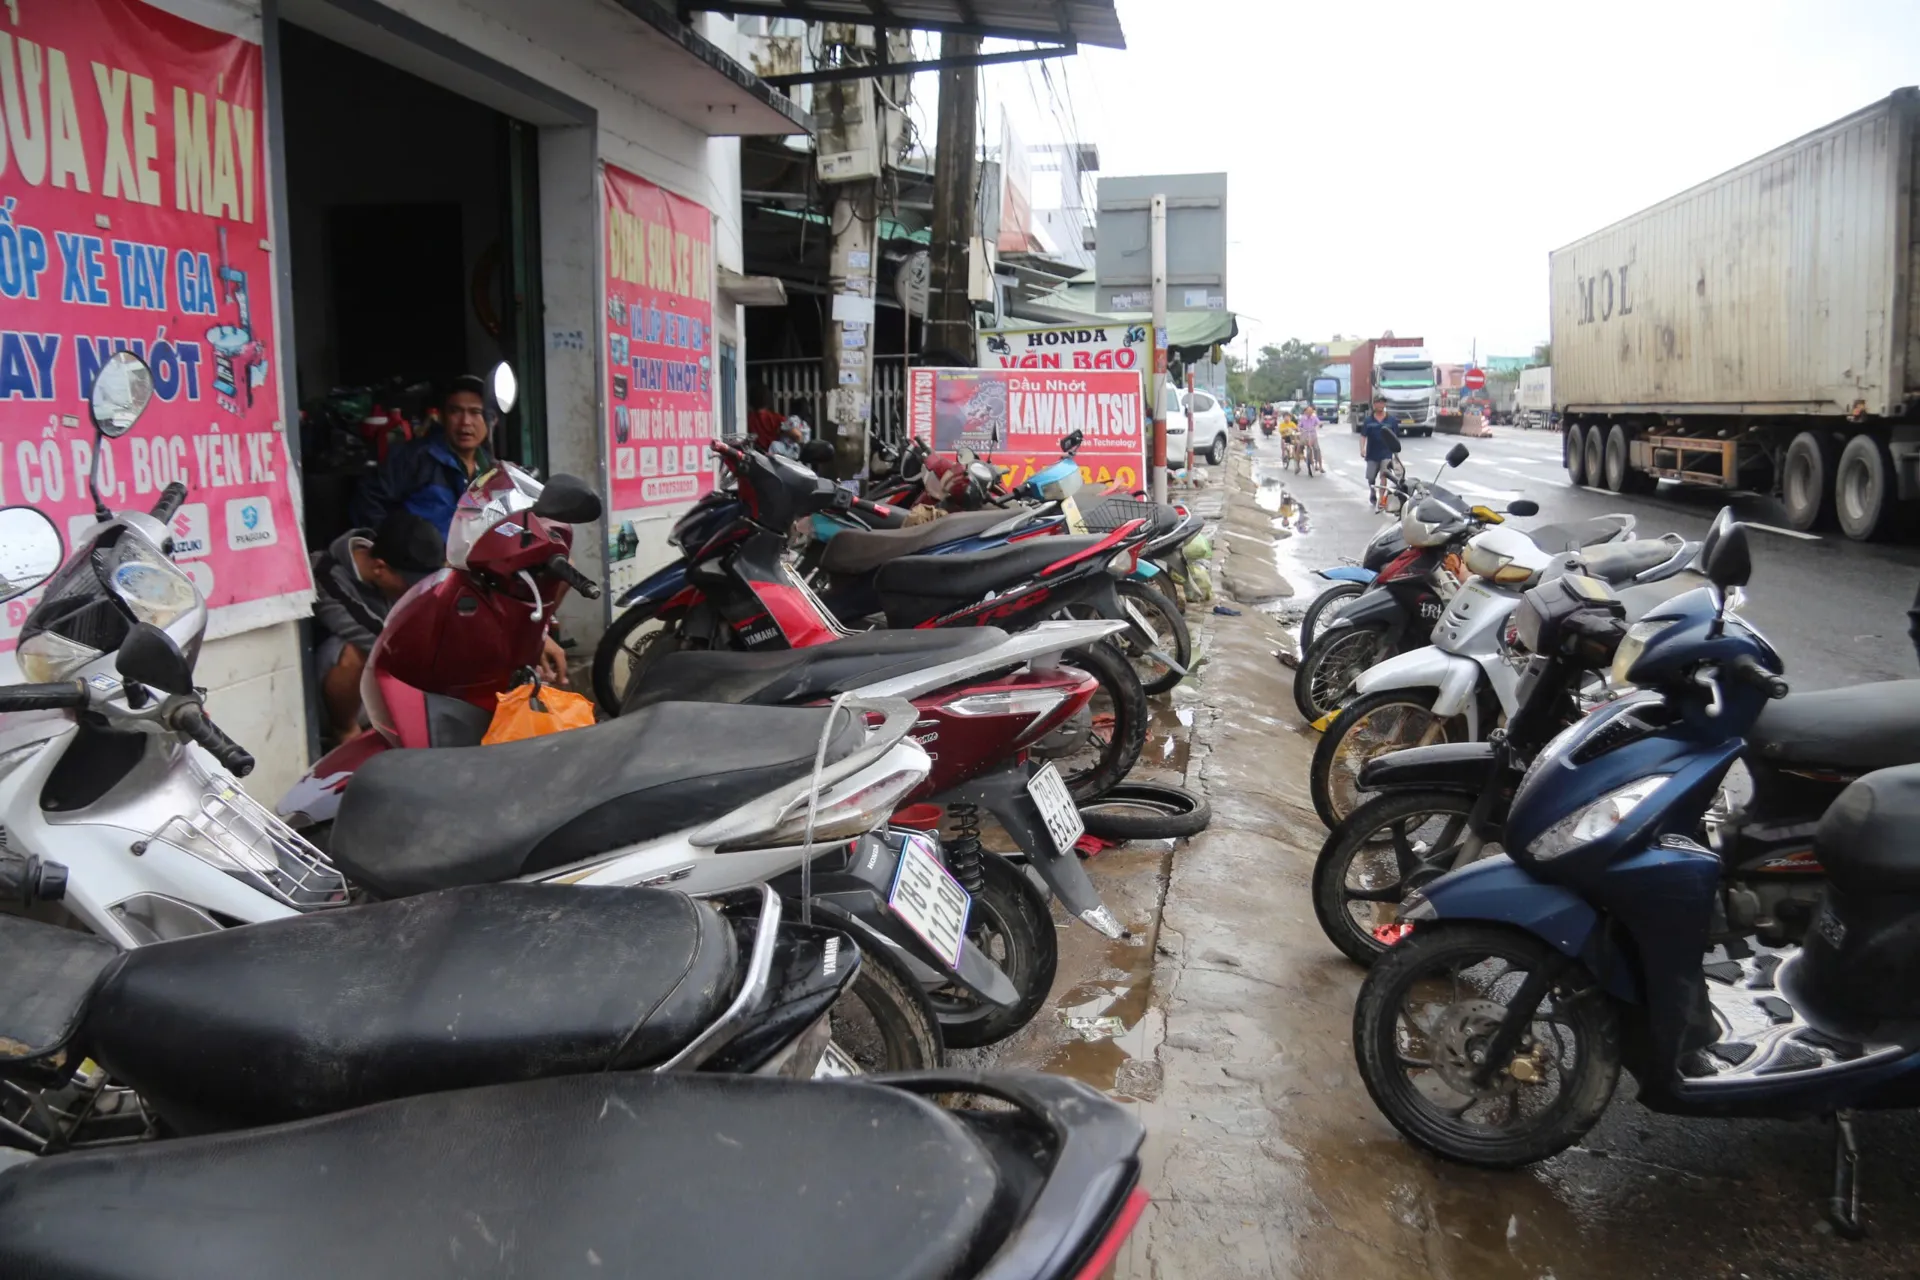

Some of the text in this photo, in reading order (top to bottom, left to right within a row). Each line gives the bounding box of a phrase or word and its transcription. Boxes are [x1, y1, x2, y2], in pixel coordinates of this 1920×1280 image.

[90, 60, 161, 207] XE
[173, 72, 254, 224] MÁY
[53, 230, 111, 307] XE
[111, 239, 168, 311] TAY
[176, 249, 218, 316] GA
[1027, 329, 1108, 346] HONDA
[74, 324, 203, 402] NỚT
[631, 355, 663, 392] THAY
[1073, 347, 1136, 370] BAO
[1008, 377, 1087, 392] Dầu Nhớt
[1008, 391, 1137, 436] KAWAMATSU
[16, 413, 65, 504] CỔ
[192, 422, 244, 489] YÊN
[246, 431, 277, 484] XE
[1094, 438, 1137, 449] Technology
[744, 626, 778, 647] YAMAHA
[866, 843, 880, 870] HONDA
[928, 874, 965, 958] 112.80
[822, 935, 842, 977] YAMAHA
